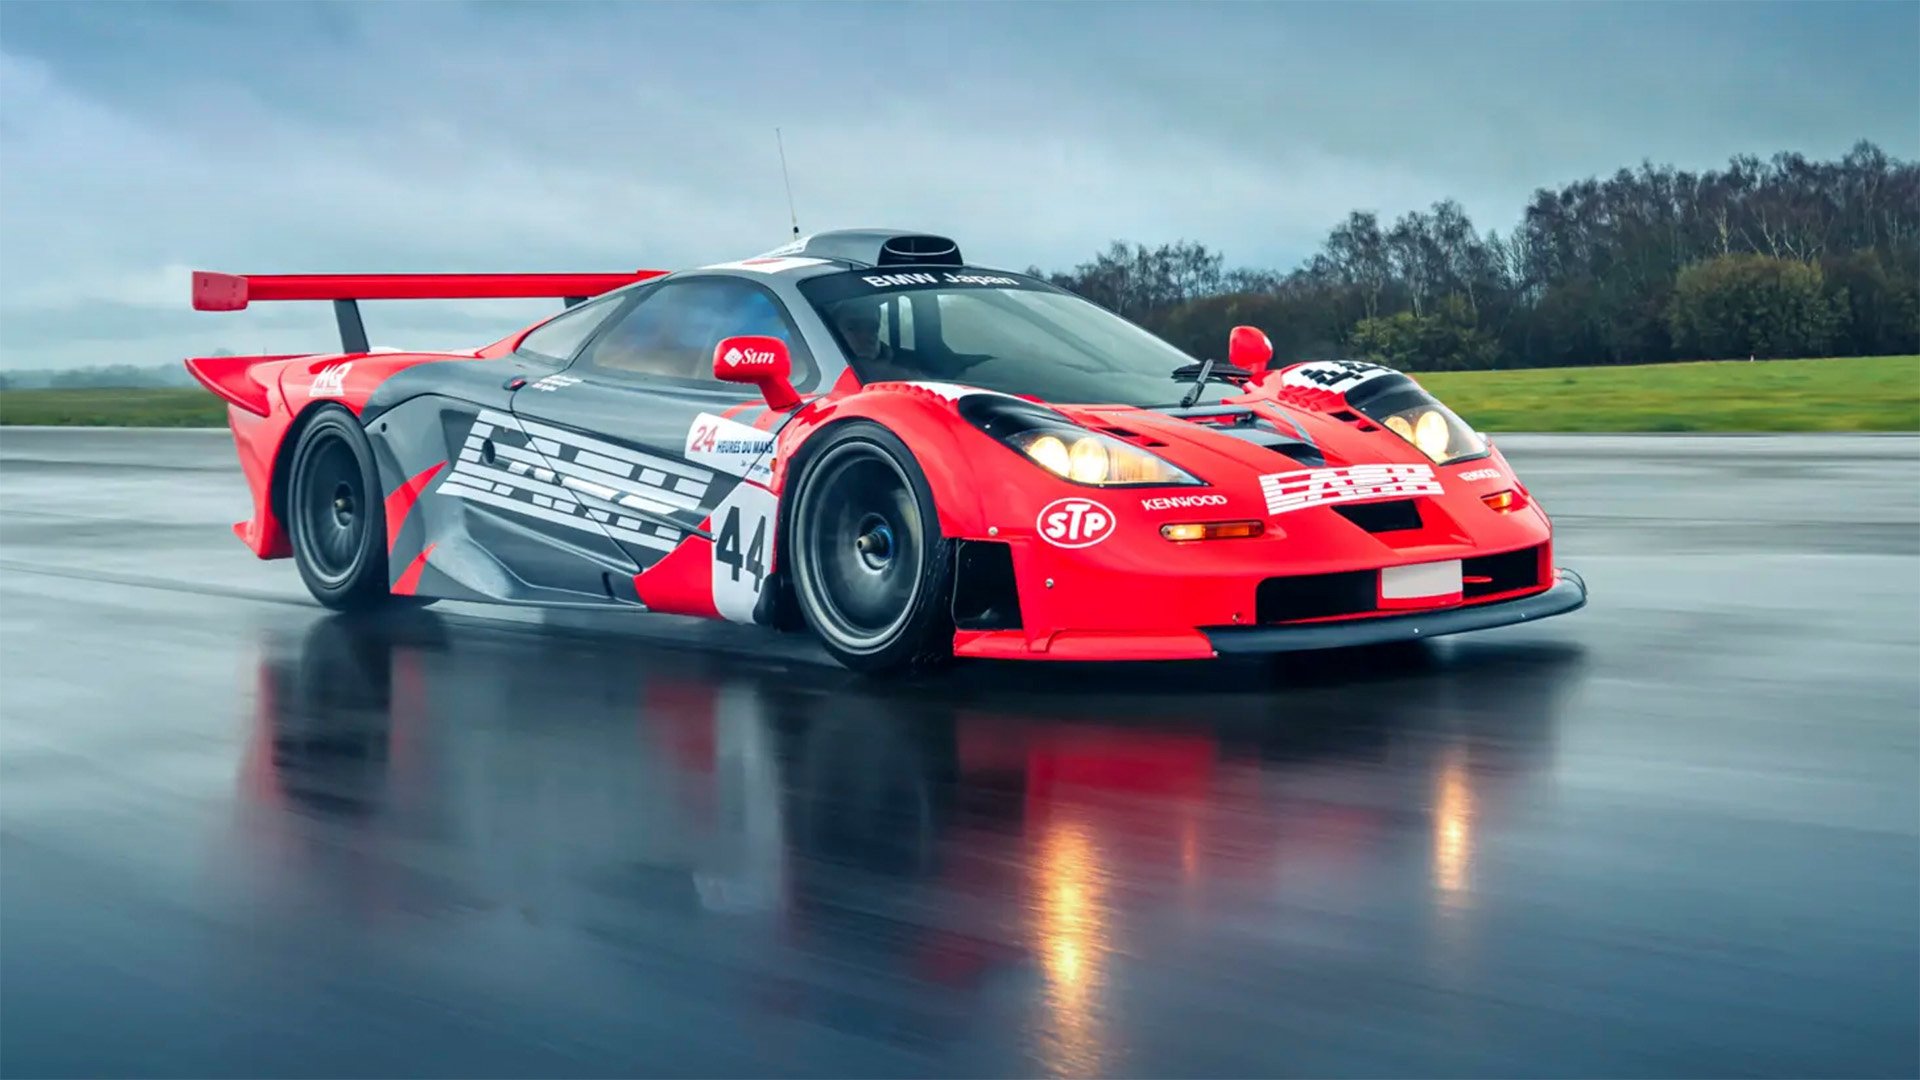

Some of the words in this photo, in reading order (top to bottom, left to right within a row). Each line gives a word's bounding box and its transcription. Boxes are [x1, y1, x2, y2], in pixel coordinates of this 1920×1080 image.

[862, 272, 938, 287] BMW
[943, 272, 1020, 286] Japan
[742, 347, 775, 364] Sun
[689, 425, 718, 453] 24
[716, 440, 741, 454] HEURES
[741, 440, 752, 454] DU
[752, 440, 774, 454] MANS
[1141, 495, 1228, 511] KENWOOD
[1045, 503, 1106, 540] STP
[715, 505, 766, 594] 44
